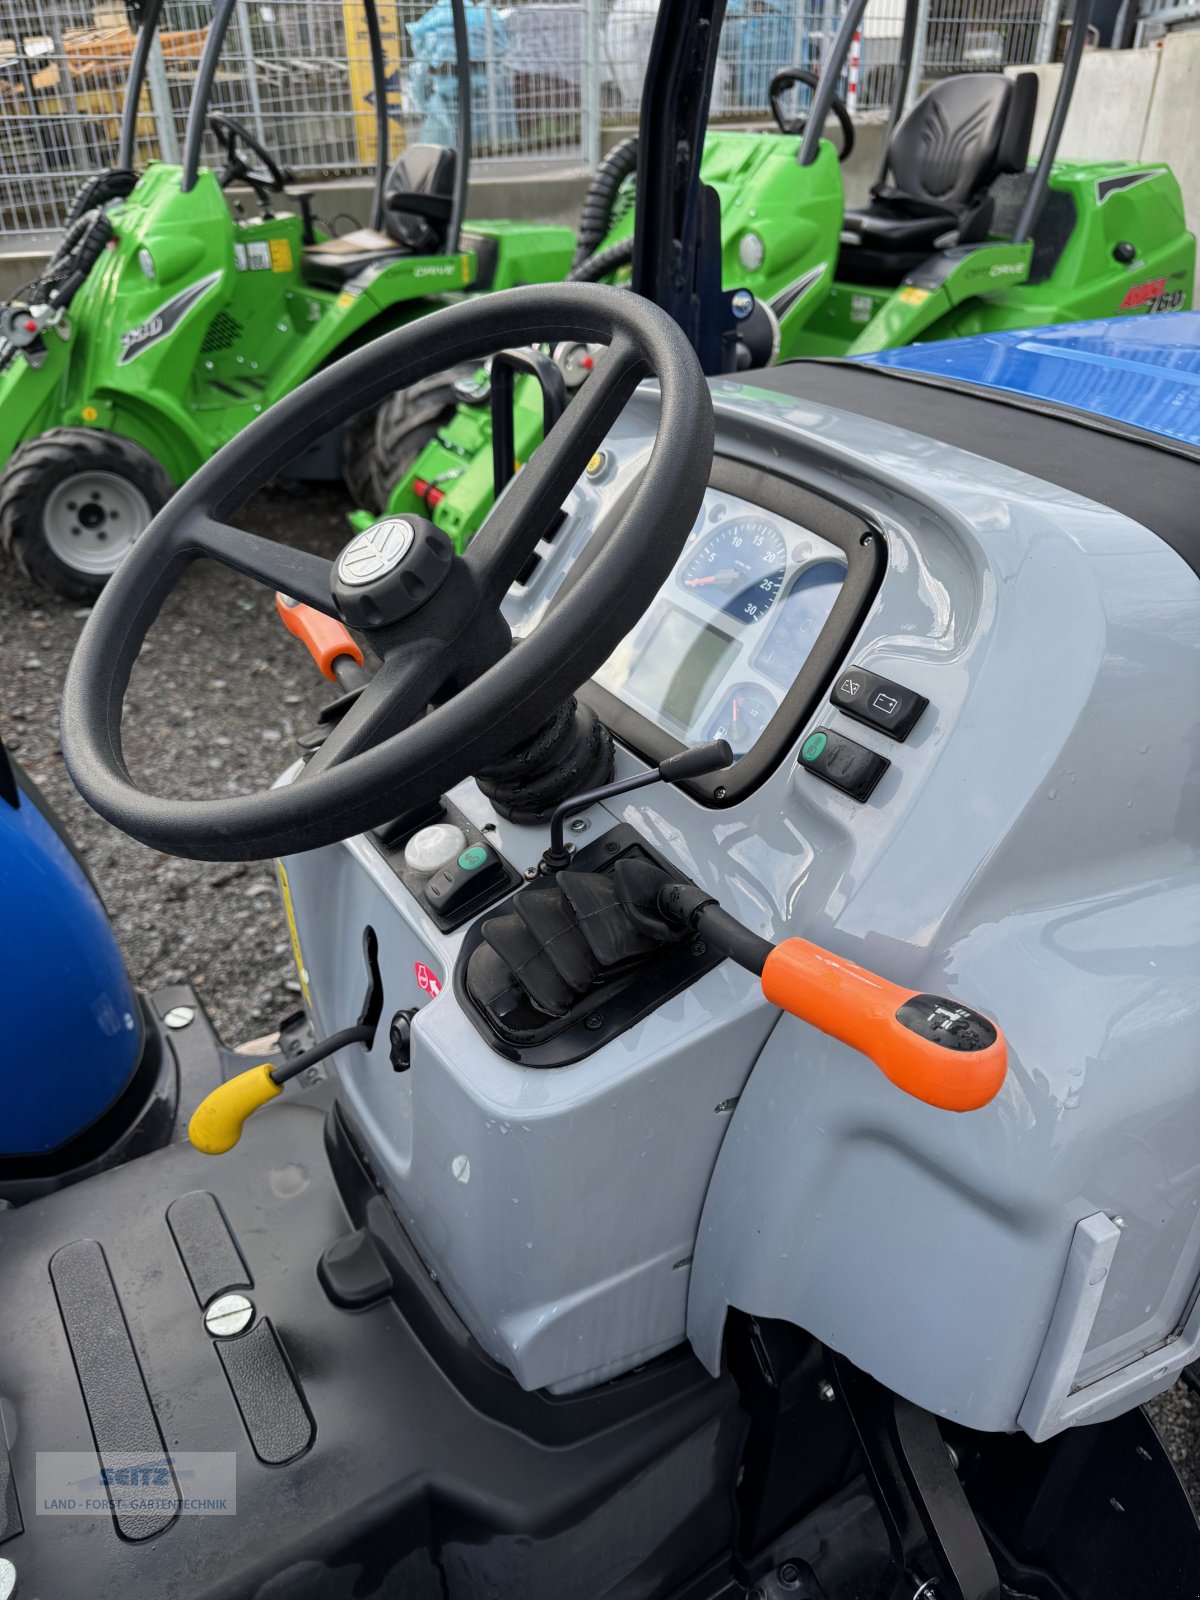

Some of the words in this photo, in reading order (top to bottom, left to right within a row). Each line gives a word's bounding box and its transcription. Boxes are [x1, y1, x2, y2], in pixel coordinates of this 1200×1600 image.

[731, 535, 743, 548] 10
[752, 535, 765, 547] 15
[708, 552, 717, 563] 5
[763, 551, 776, 564] 20
[759, 579, 774, 591] 25
[744, 603, 757, 615] 30
